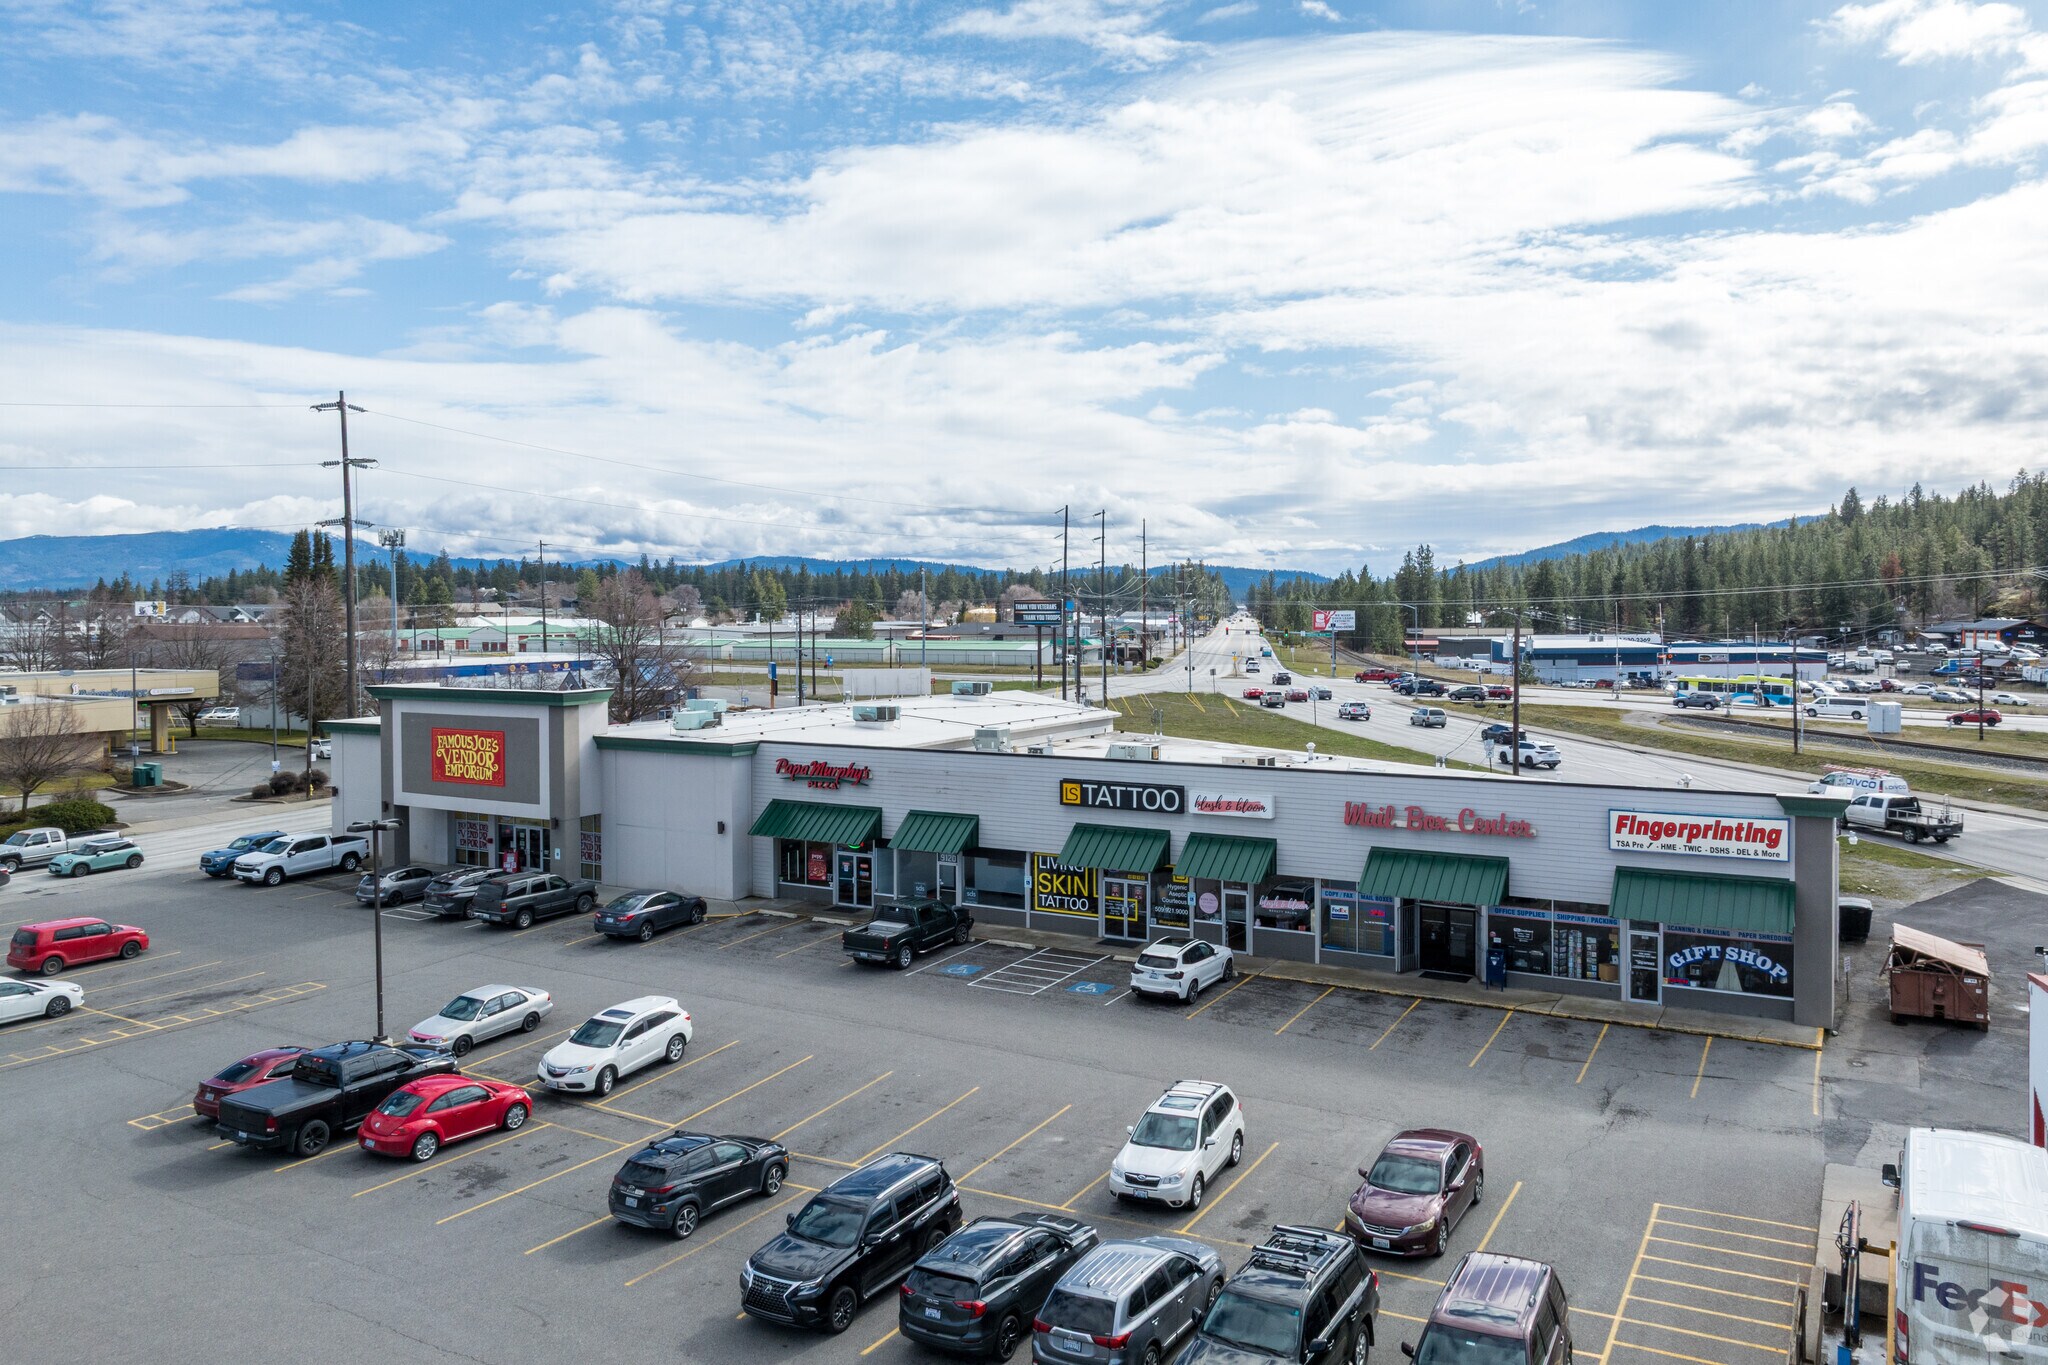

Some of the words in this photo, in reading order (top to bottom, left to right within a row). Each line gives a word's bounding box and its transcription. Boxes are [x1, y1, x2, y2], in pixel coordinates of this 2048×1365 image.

[437, 734, 474, 749] FAMOUS
[472, 735, 499, 753] JOE'S
[436, 748, 499, 772] VENDOR
[776, 758, 811, 782] Papa
[810, 760, 872, 787] Murphy's
[1065, 787, 1079, 801] LS
[1082, 784, 1180, 812] TATTOO
[1194, 795, 1223, 811] blush
[1225, 801, 1232, 811] &
[1235, 798, 1268, 814] bloom
[1343, 801, 1396, 828] Mail
[1404, 806, 1450, 832] Box
[1458, 808, 1535, 837] Center
[1615, 815, 1783, 849] Fingerprinting
[940, 853, 957, 862] 9120
[1616, 840, 1630, 848] TSA
[1632, 841, 1644, 849] Pre
[1660, 843, 1676, 851] HME
[1683, 844, 1702, 853] TWIC
[1709, 846, 1730, 855] DSHS
[1736, 848, 1751, 856] DEL
[1753, 849, 1759, 857] &
[1761, 850, 1781, 858] More
[1038, 868, 1089, 897] SKIN
[966, 890, 977, 898] sds
[1038, 894, 1089, 911] TATTOO
[1161, 897, 1187, 905] Courteous
[1361, 894, 1374, 902] MAIL
[1494, 907, 1516, 916] OFFICE
[1516, 909, 1546, 918] SUPPLIES
[1556, 913, 1586, 923] SHIPPING
[1590, 917, 1618, 926] PACKING
[1667, 924, 1696, 933] SCANNING
[1702, 928, 1731, 937] EMAILING
[1738, 931, 1757, 939] PAPER
[1758, 933, 1793, 942] SHREDDING
[1669, 944, 1722, 970] GIFT
[1724, 945, 1789, 979] SHOP
[2002, 1323, 2048, 1344] Gound
